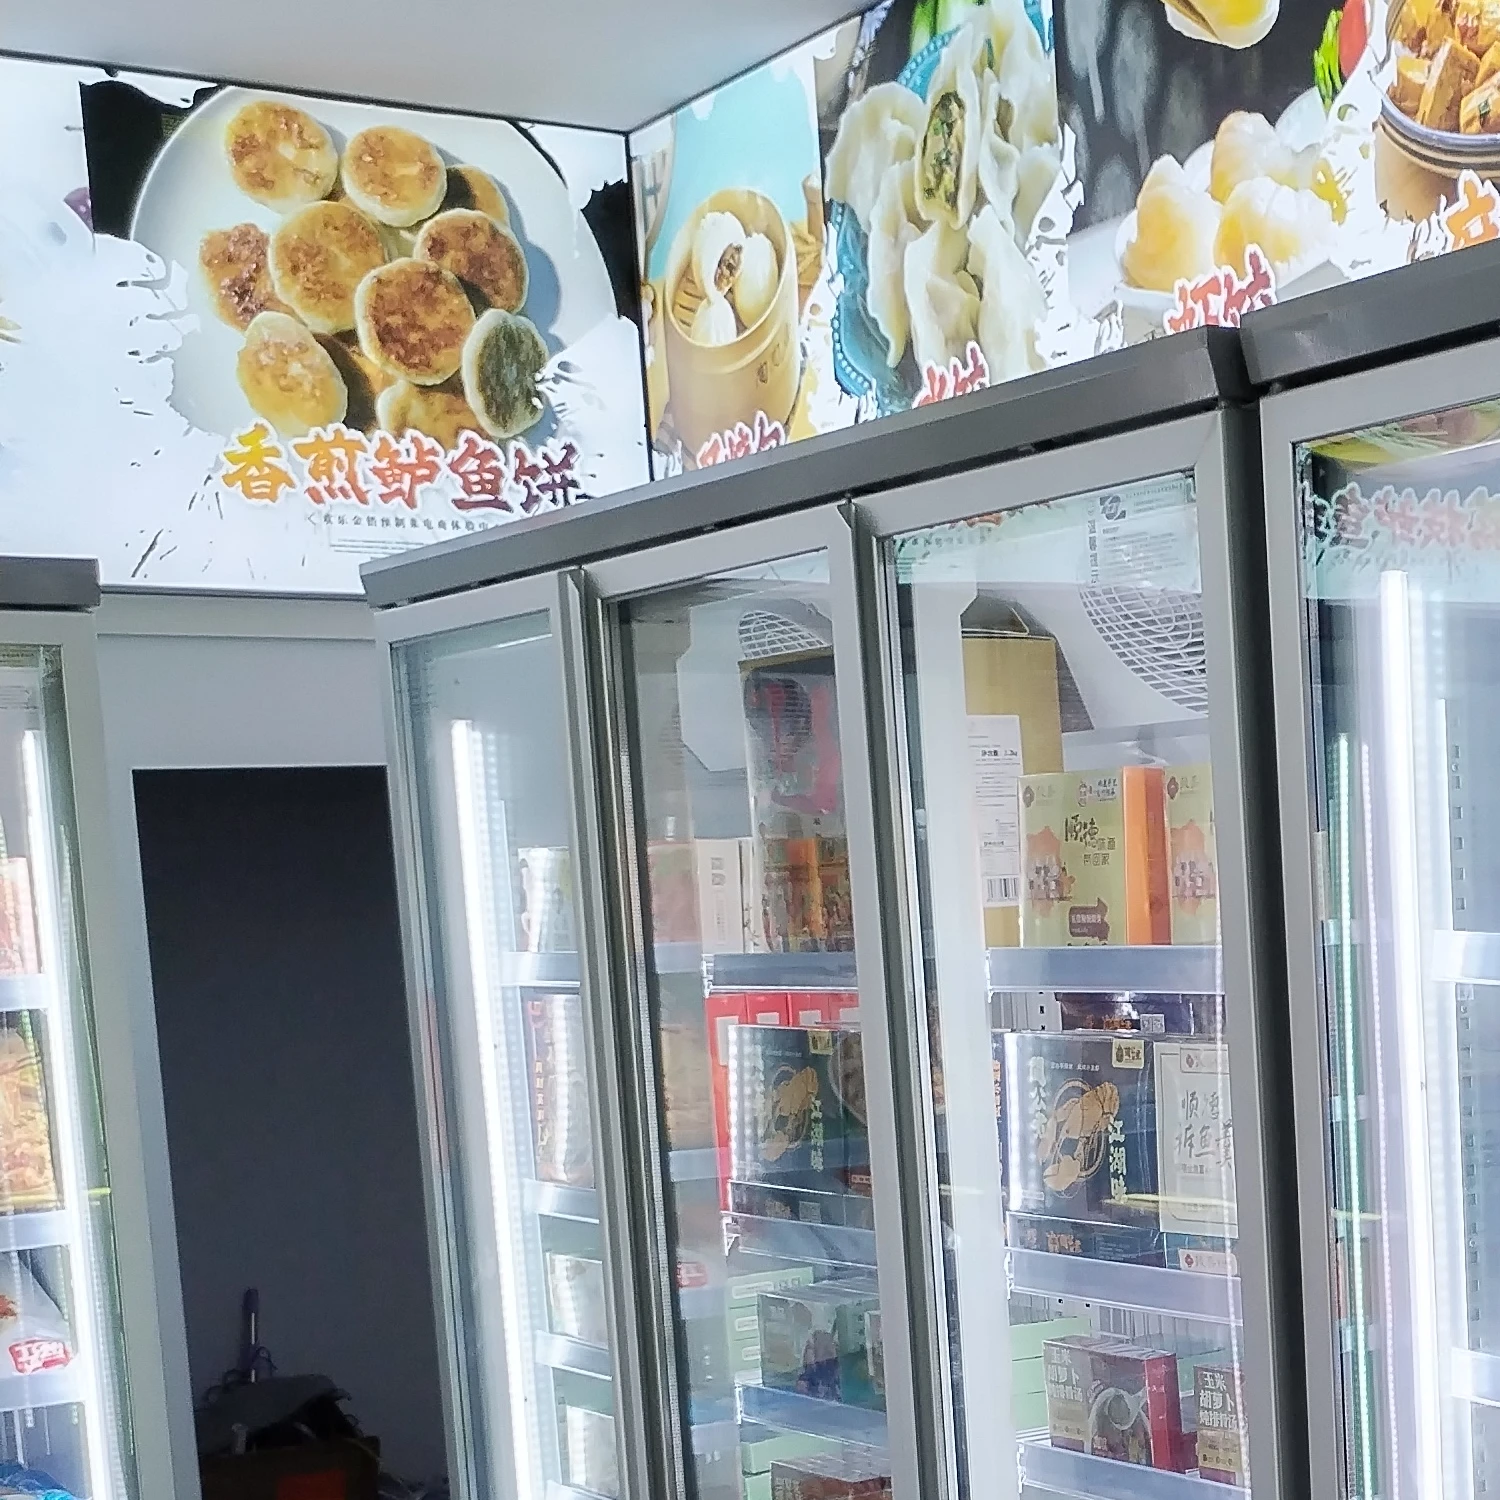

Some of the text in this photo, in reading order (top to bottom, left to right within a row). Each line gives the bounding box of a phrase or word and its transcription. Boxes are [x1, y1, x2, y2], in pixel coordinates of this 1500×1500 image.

[221, 421, 584, 514] 香煎鲈鱼饼
[1203, 1370, 1226, 1391] 玉米
[1200, 1389, 1234, 1412] 胡萝卜
